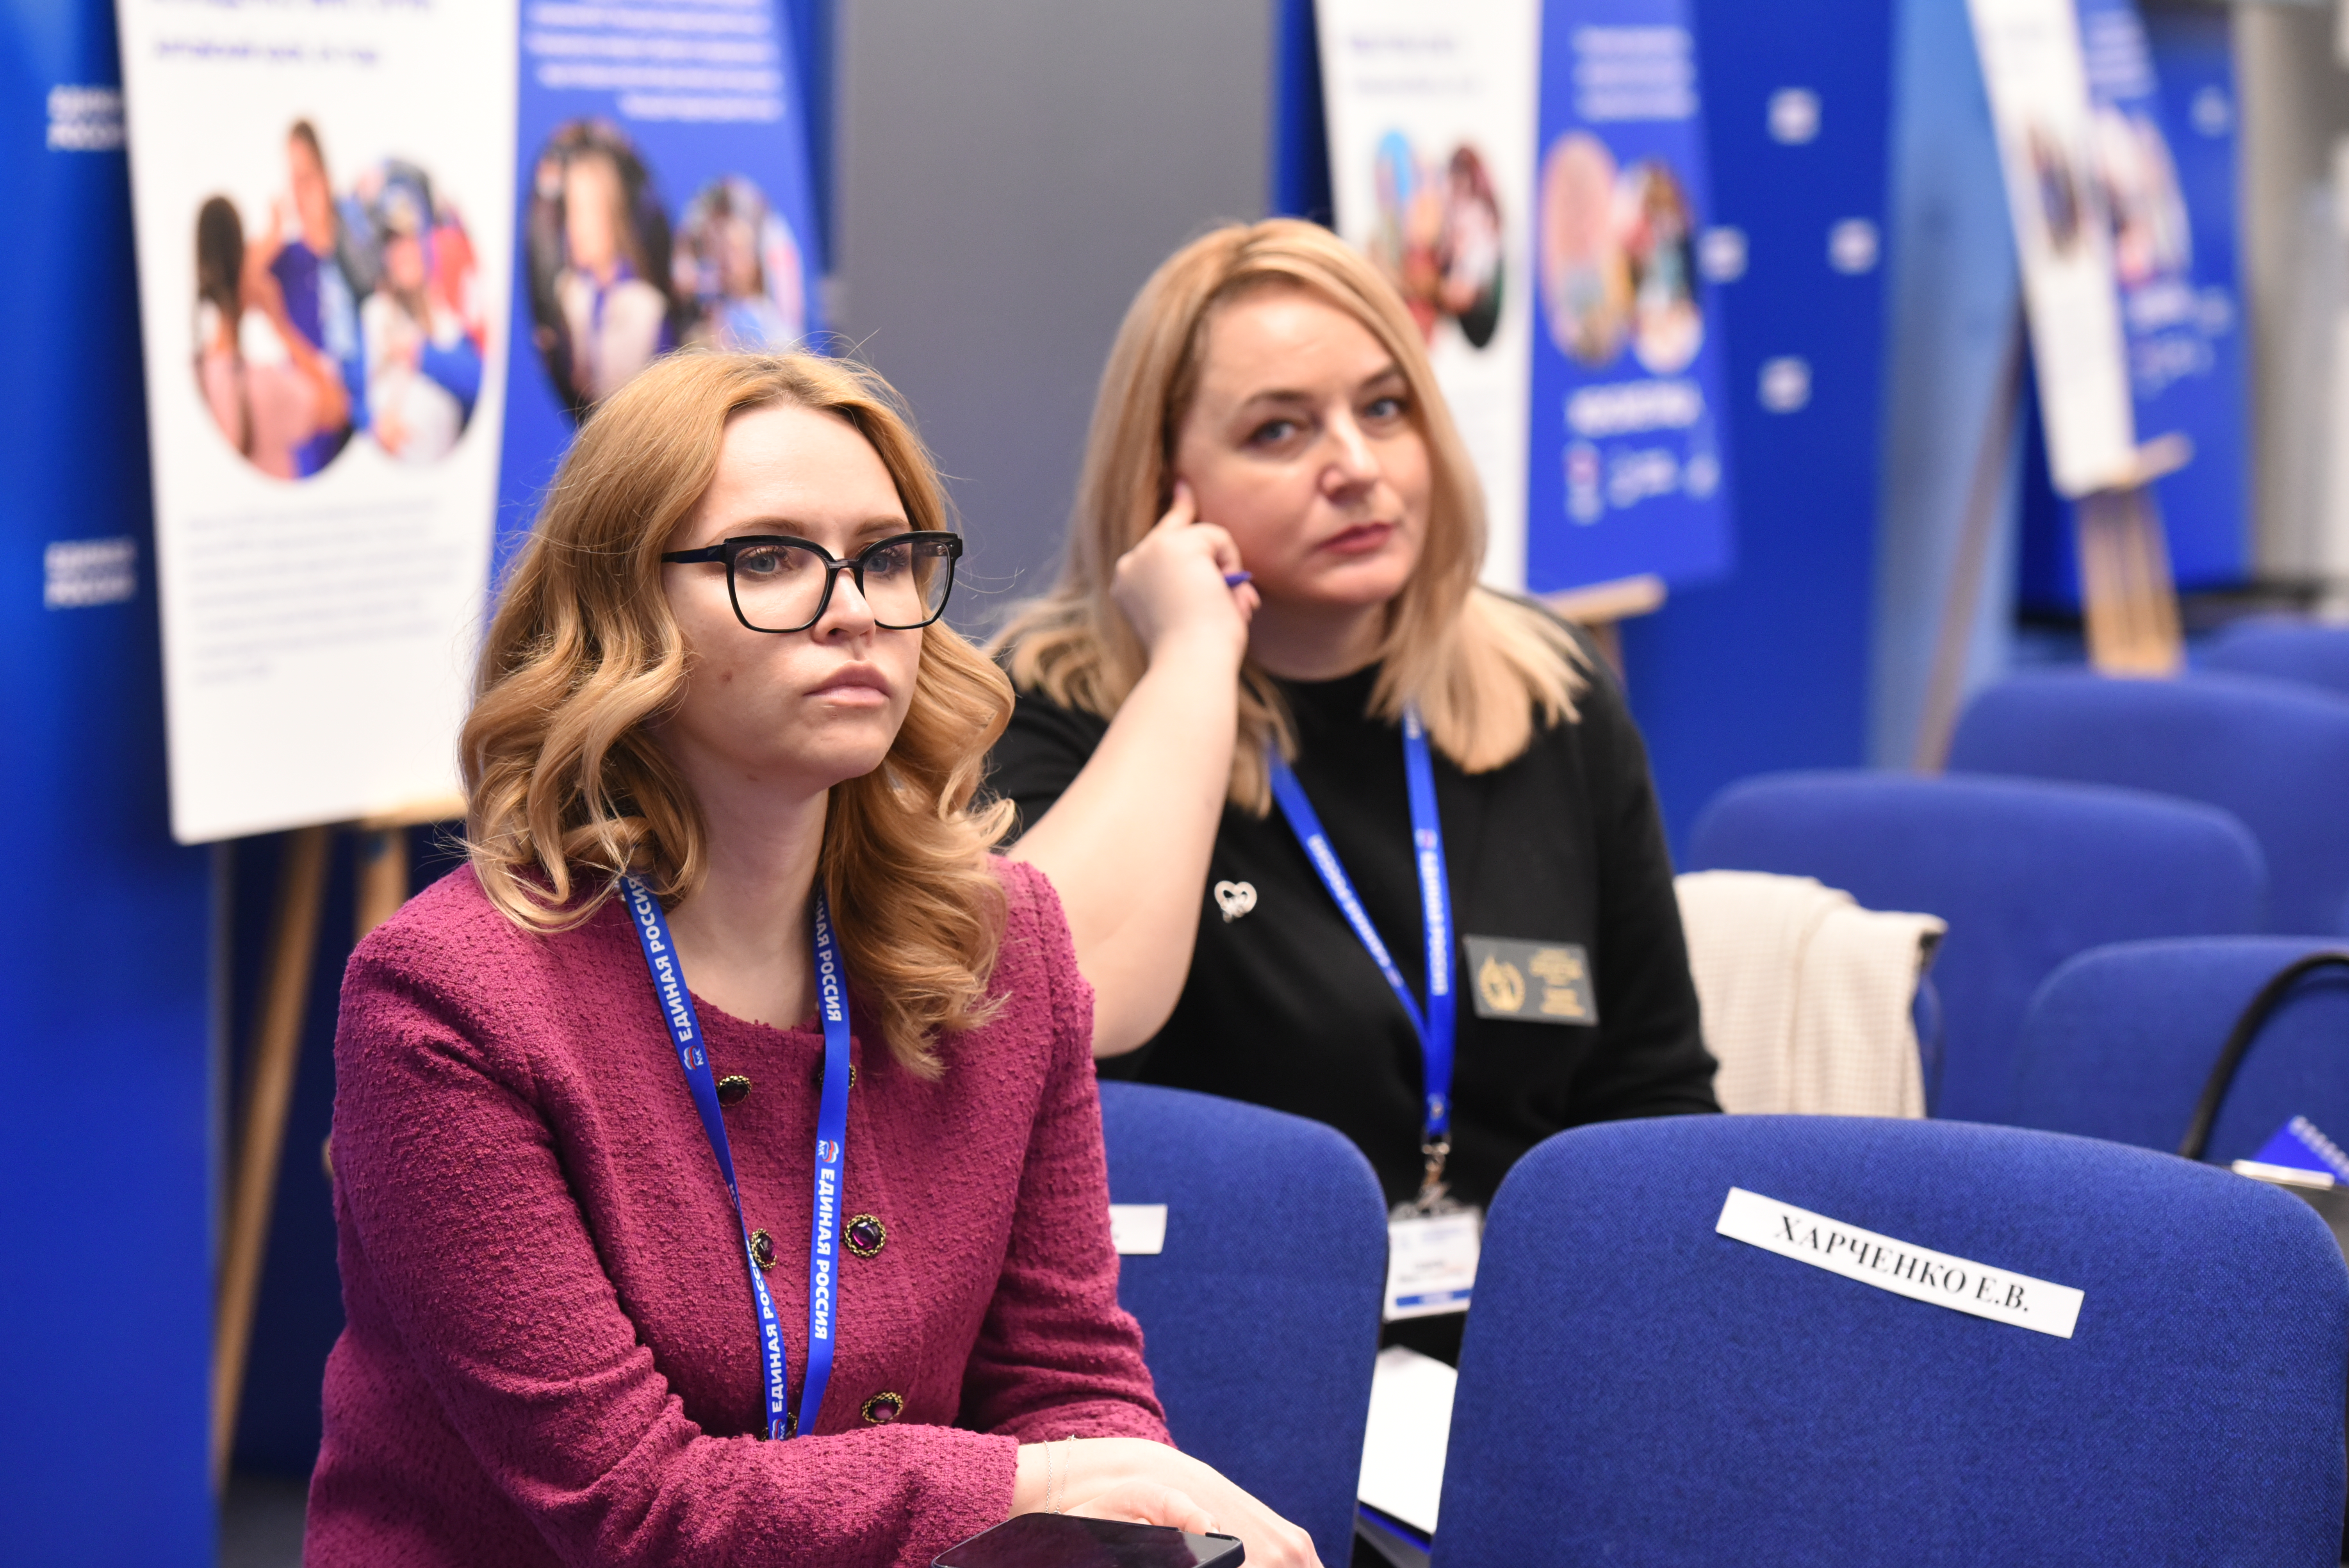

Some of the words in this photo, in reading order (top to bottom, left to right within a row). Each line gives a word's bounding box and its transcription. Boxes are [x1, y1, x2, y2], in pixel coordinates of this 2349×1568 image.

[655, 955, 693, 1042] ЕДИНАЯ
[819, 949, 842, 1021] РОССИЯ
[817, 1168, 835, 1255] ЕДИНАЯ
[814, 1259, 831, 1340] РОССИЯ
[1775, 1215, 1967, 1294] ХАРЧЕНКО
[1976, 1277, 2029, 1312] Е.В.
[766, 1323, 784, 1413] ЕДИНАЯ
